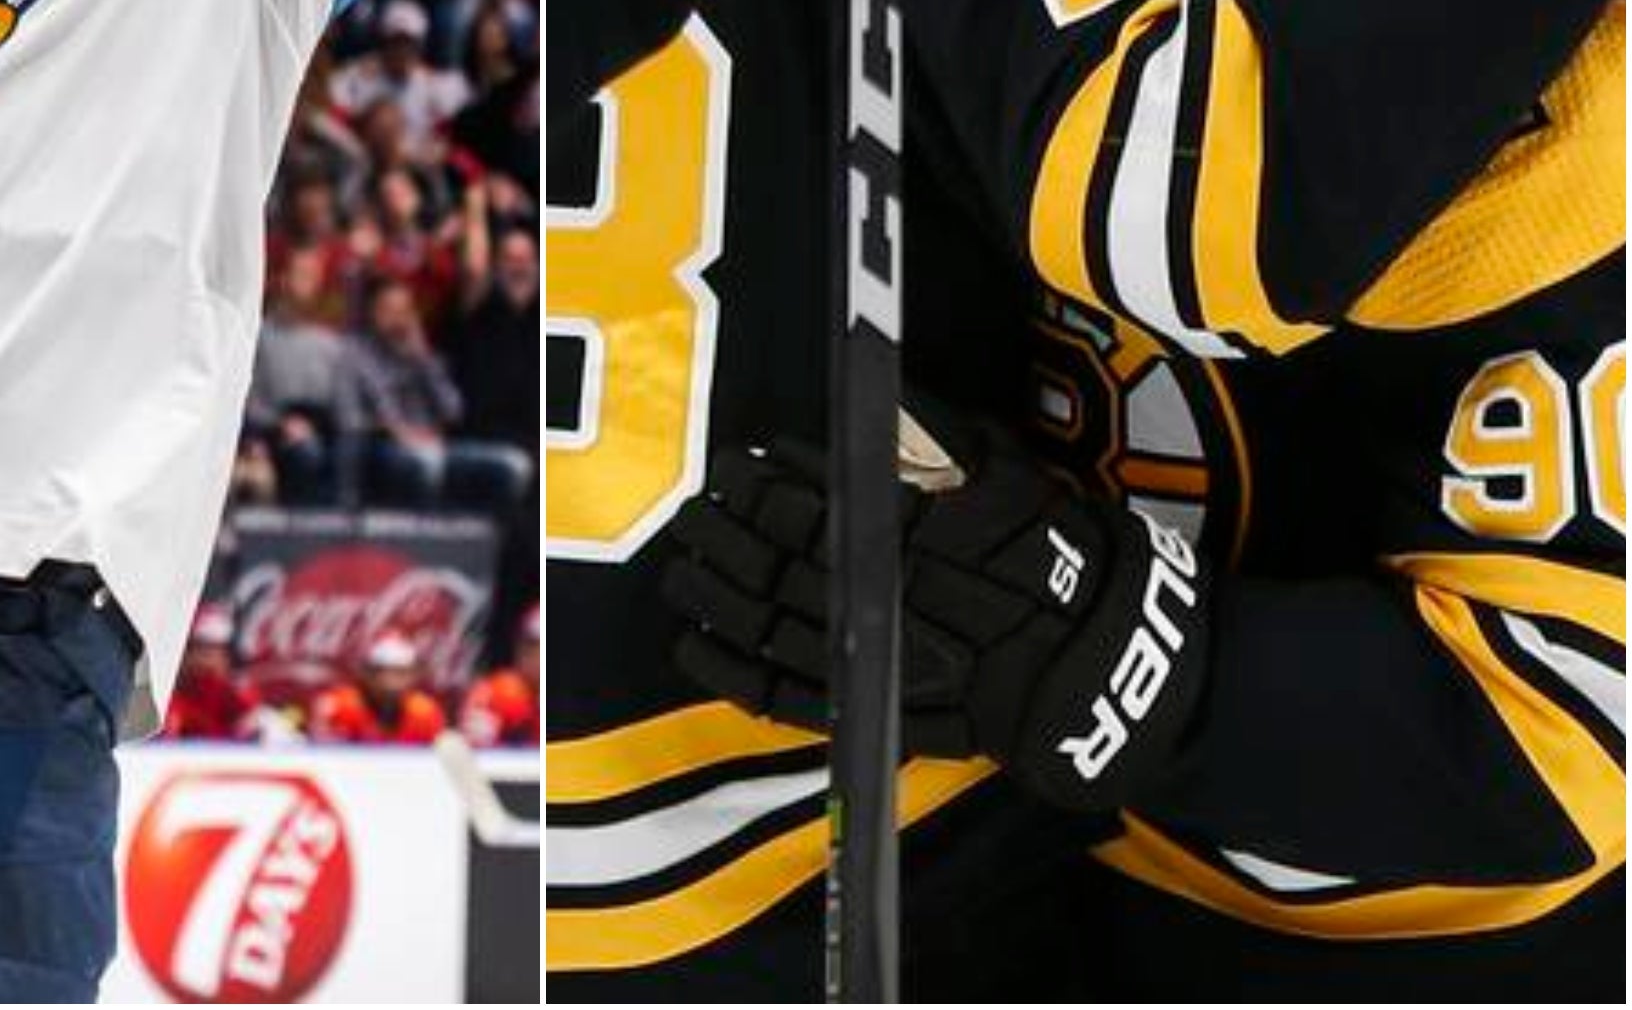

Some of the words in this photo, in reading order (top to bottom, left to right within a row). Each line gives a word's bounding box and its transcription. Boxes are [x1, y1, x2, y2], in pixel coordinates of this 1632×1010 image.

[1056, 508, 1198, 780] AUER
[156, 774, 300, 999] 7
[226, 796, 340, 988] DAYS
